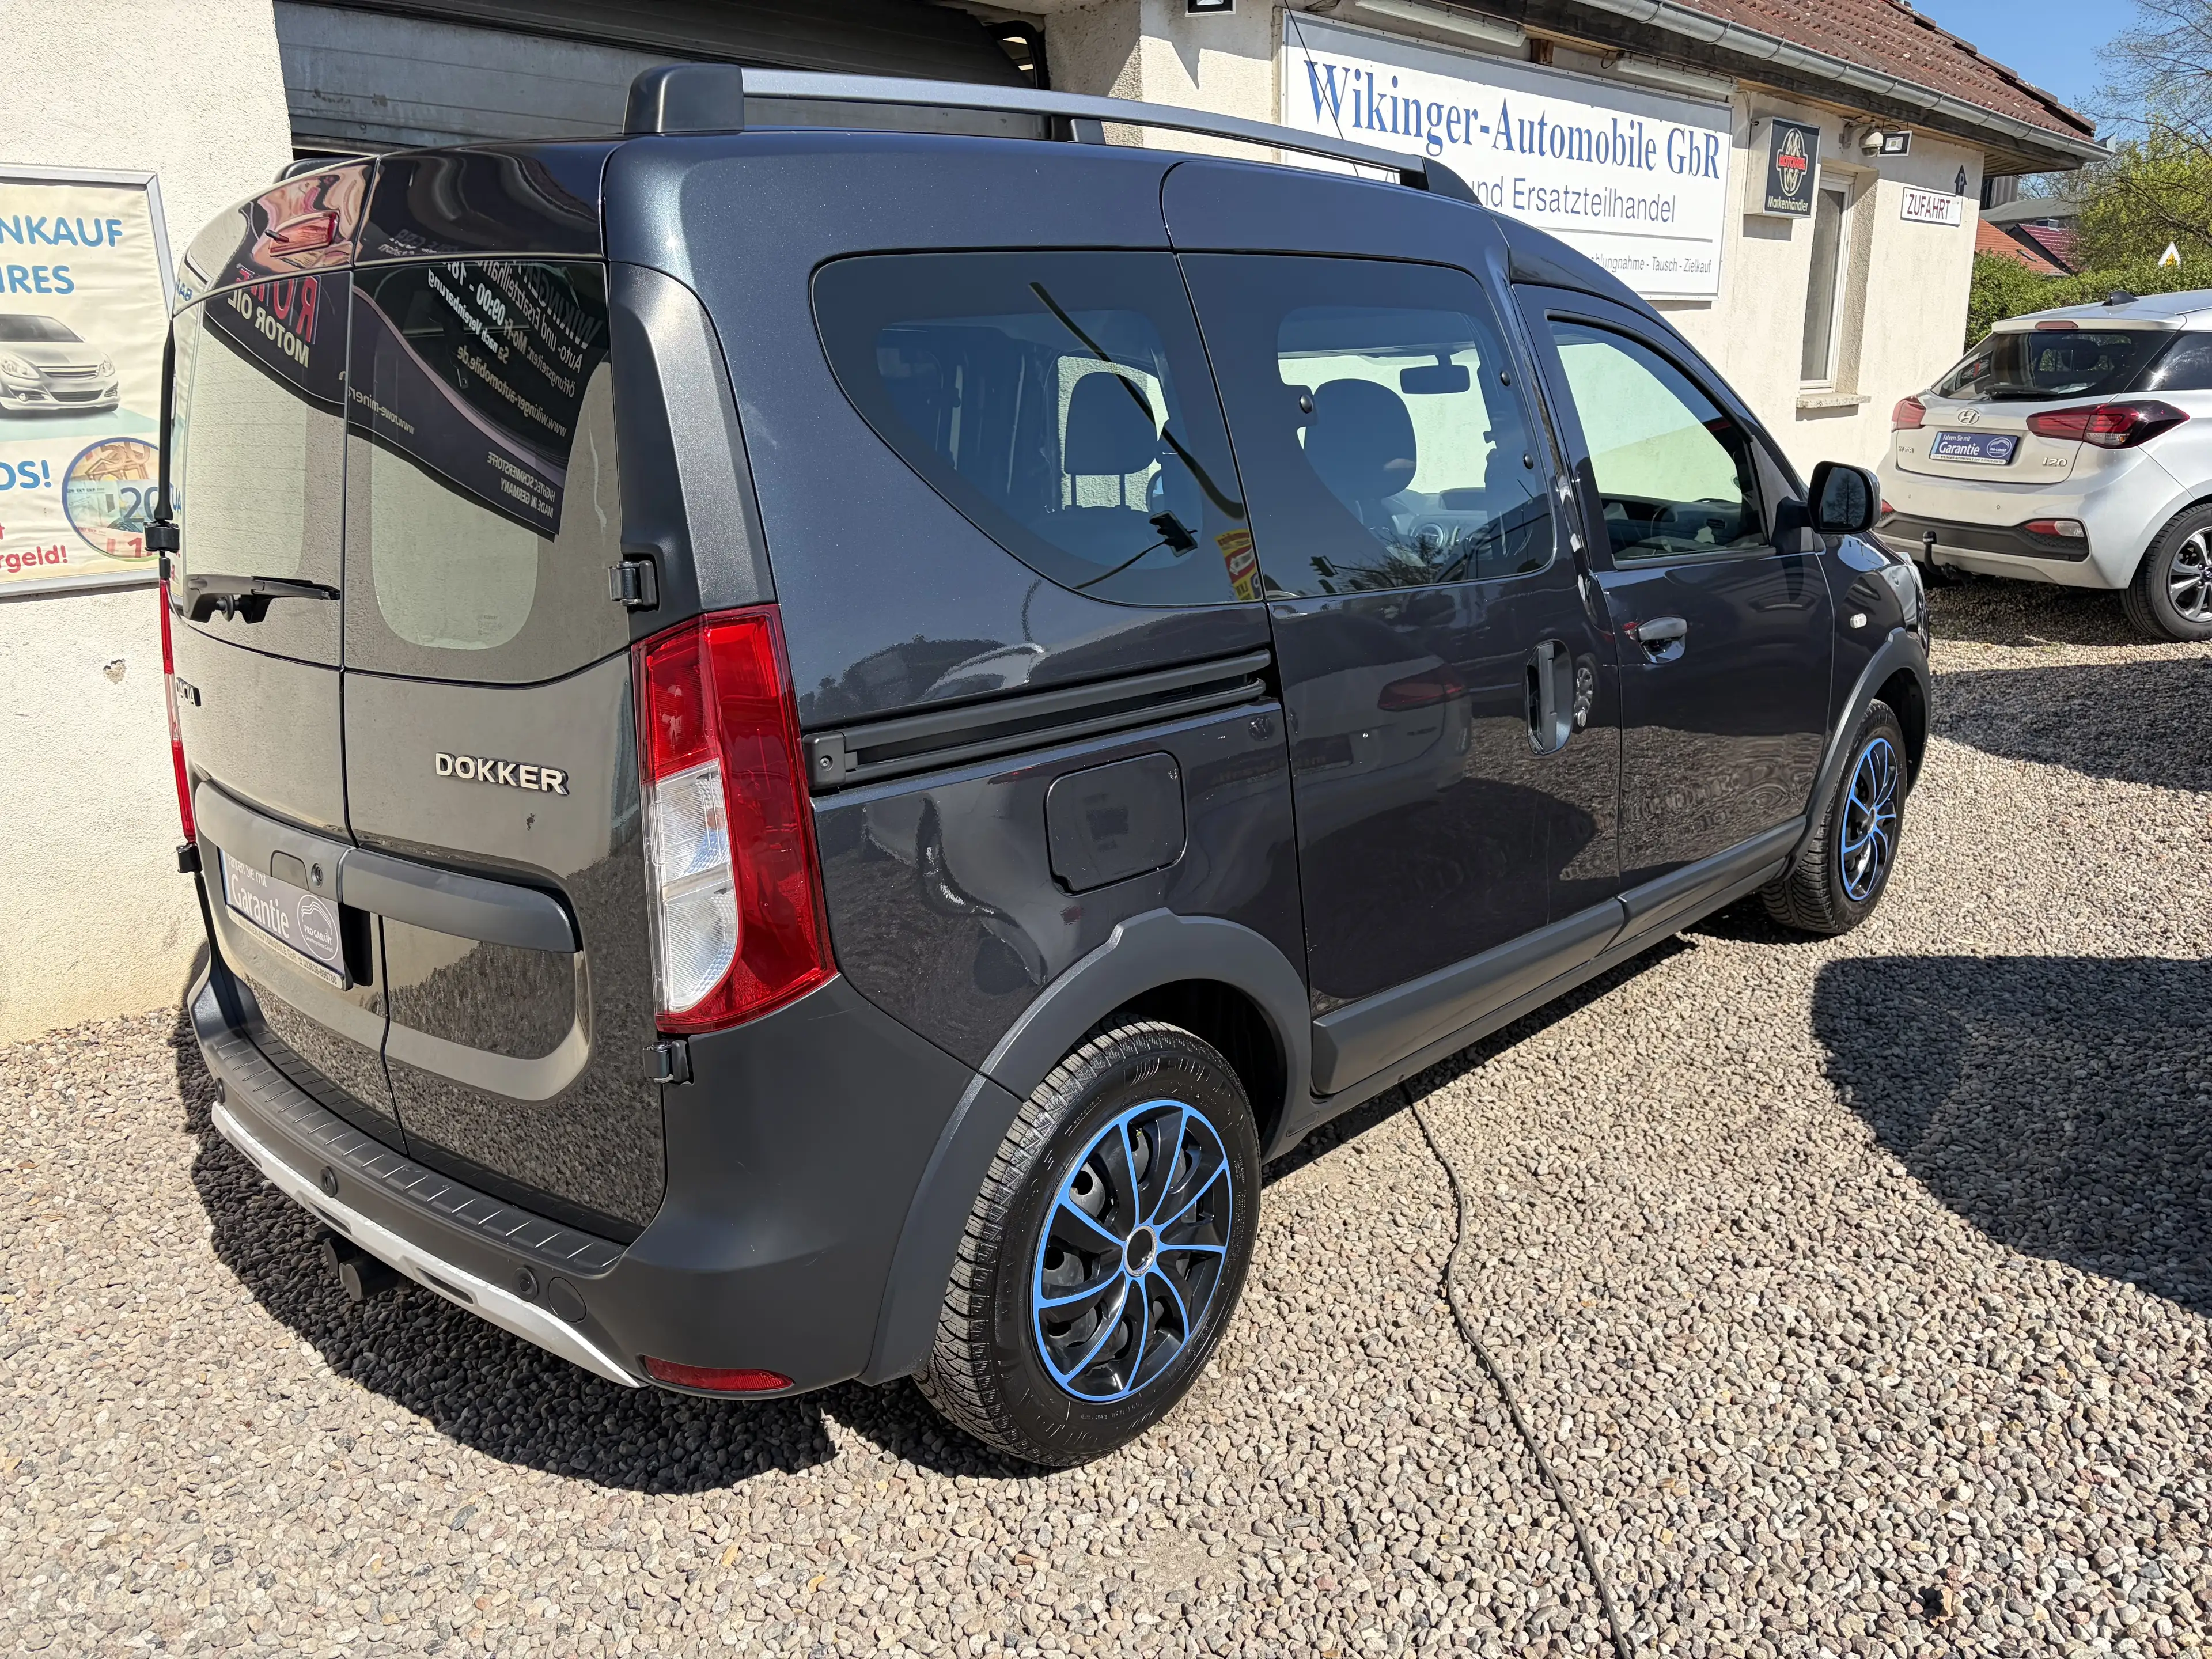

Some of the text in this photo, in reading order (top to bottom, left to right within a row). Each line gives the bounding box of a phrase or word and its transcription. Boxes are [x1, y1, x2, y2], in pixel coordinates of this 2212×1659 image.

[1304, 60, 1719, 179] Wikinger-Automobile GbR
[1513, 178, 1676, 222] Ersatzteilhandel
[1767, 195, 1809, 213] Markenhändler
[1907, 194, 1951, 220] ZUFAHRT
[1652, 256, 1677, 272] Tausch
[1683, 258, 1712, 273] Zielkauf
[1938, 441, 1980, 456] Garantie
[435, 752, 570, 796] DOKKER
[231, 873, 290, 939] Garantie
